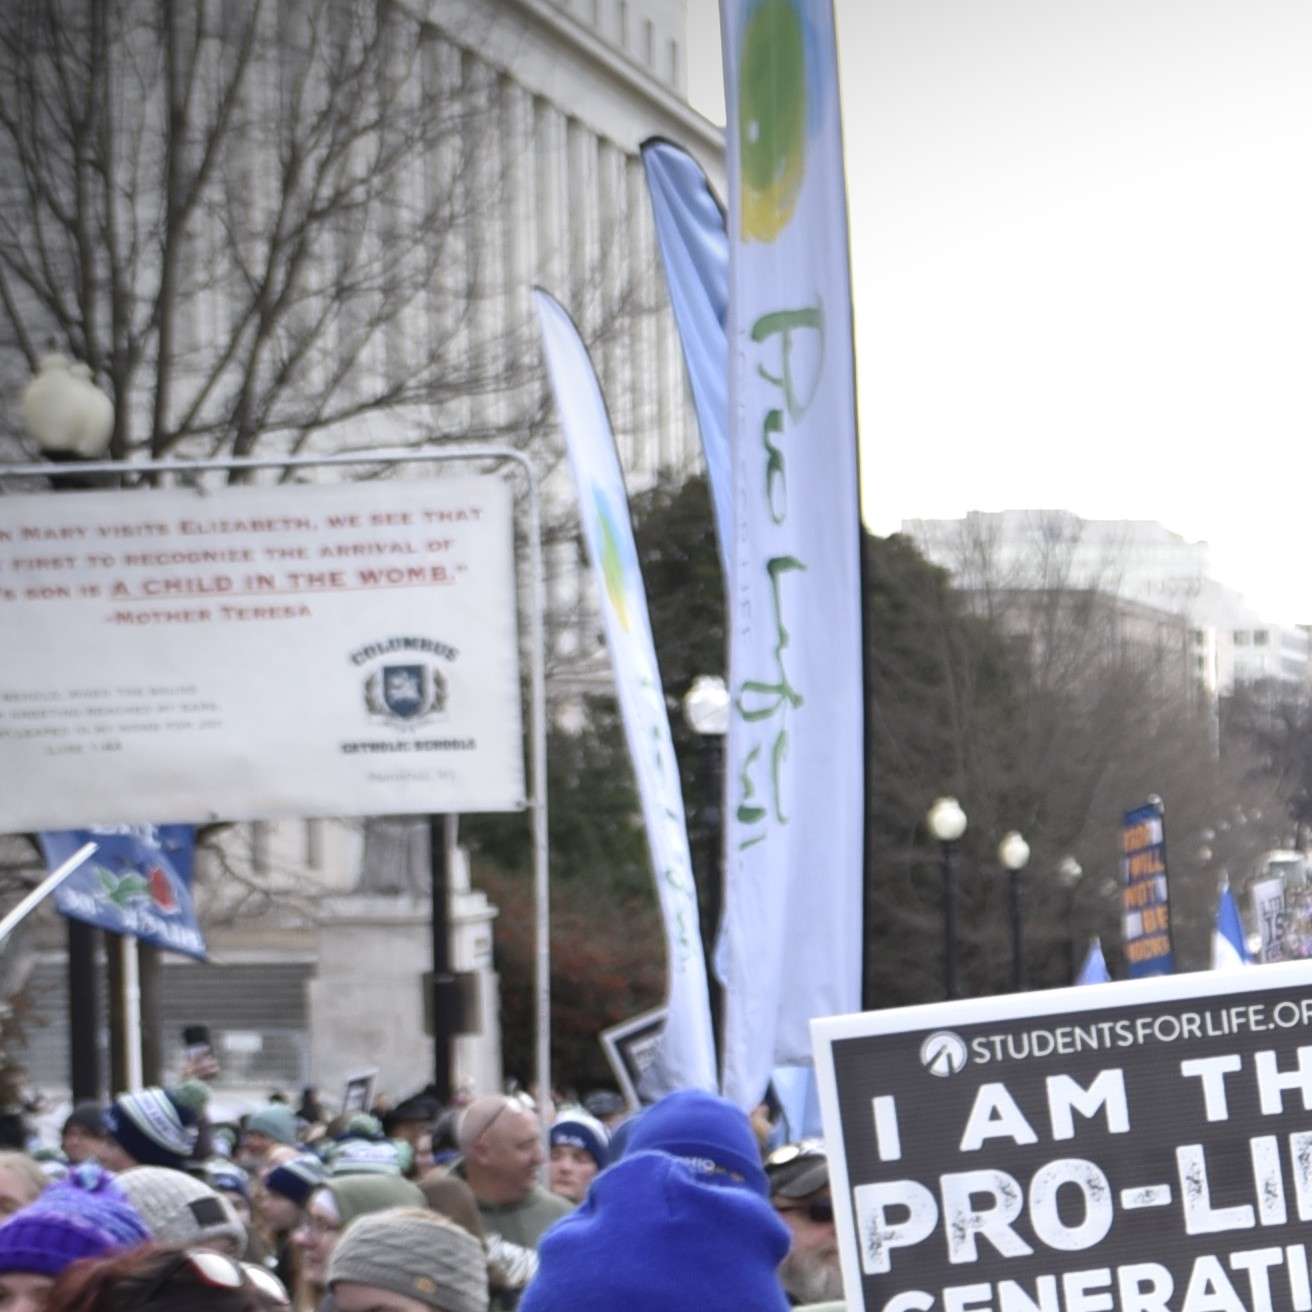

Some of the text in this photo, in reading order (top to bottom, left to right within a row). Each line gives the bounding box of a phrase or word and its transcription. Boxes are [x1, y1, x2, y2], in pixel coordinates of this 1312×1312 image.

[20, 526, 88, 541] MARY
[96, 522, 169, 537] VISITS
[327, 515, 362, 528] WE
[371, 512, 413, 526] SEE
[423, 507, 483, 522] THAT
[13, 539, 454, 570] FIRST TO RECOGNIZE THE ARRIVAL OF
[25, 586, 71, 600] SON
[112, 581, 129, 596] A
[142, 576, 233, 595] CHILD
[247, 574, 275, 590] IN
[288, 572, 345, 588] THE
[219, 604, 312, 621] TERESA
[349, 637, 460, 666] COLUMBUS
[871, 1094, 902, 1162] I
[959, 1067, 1132, 1152] AM
